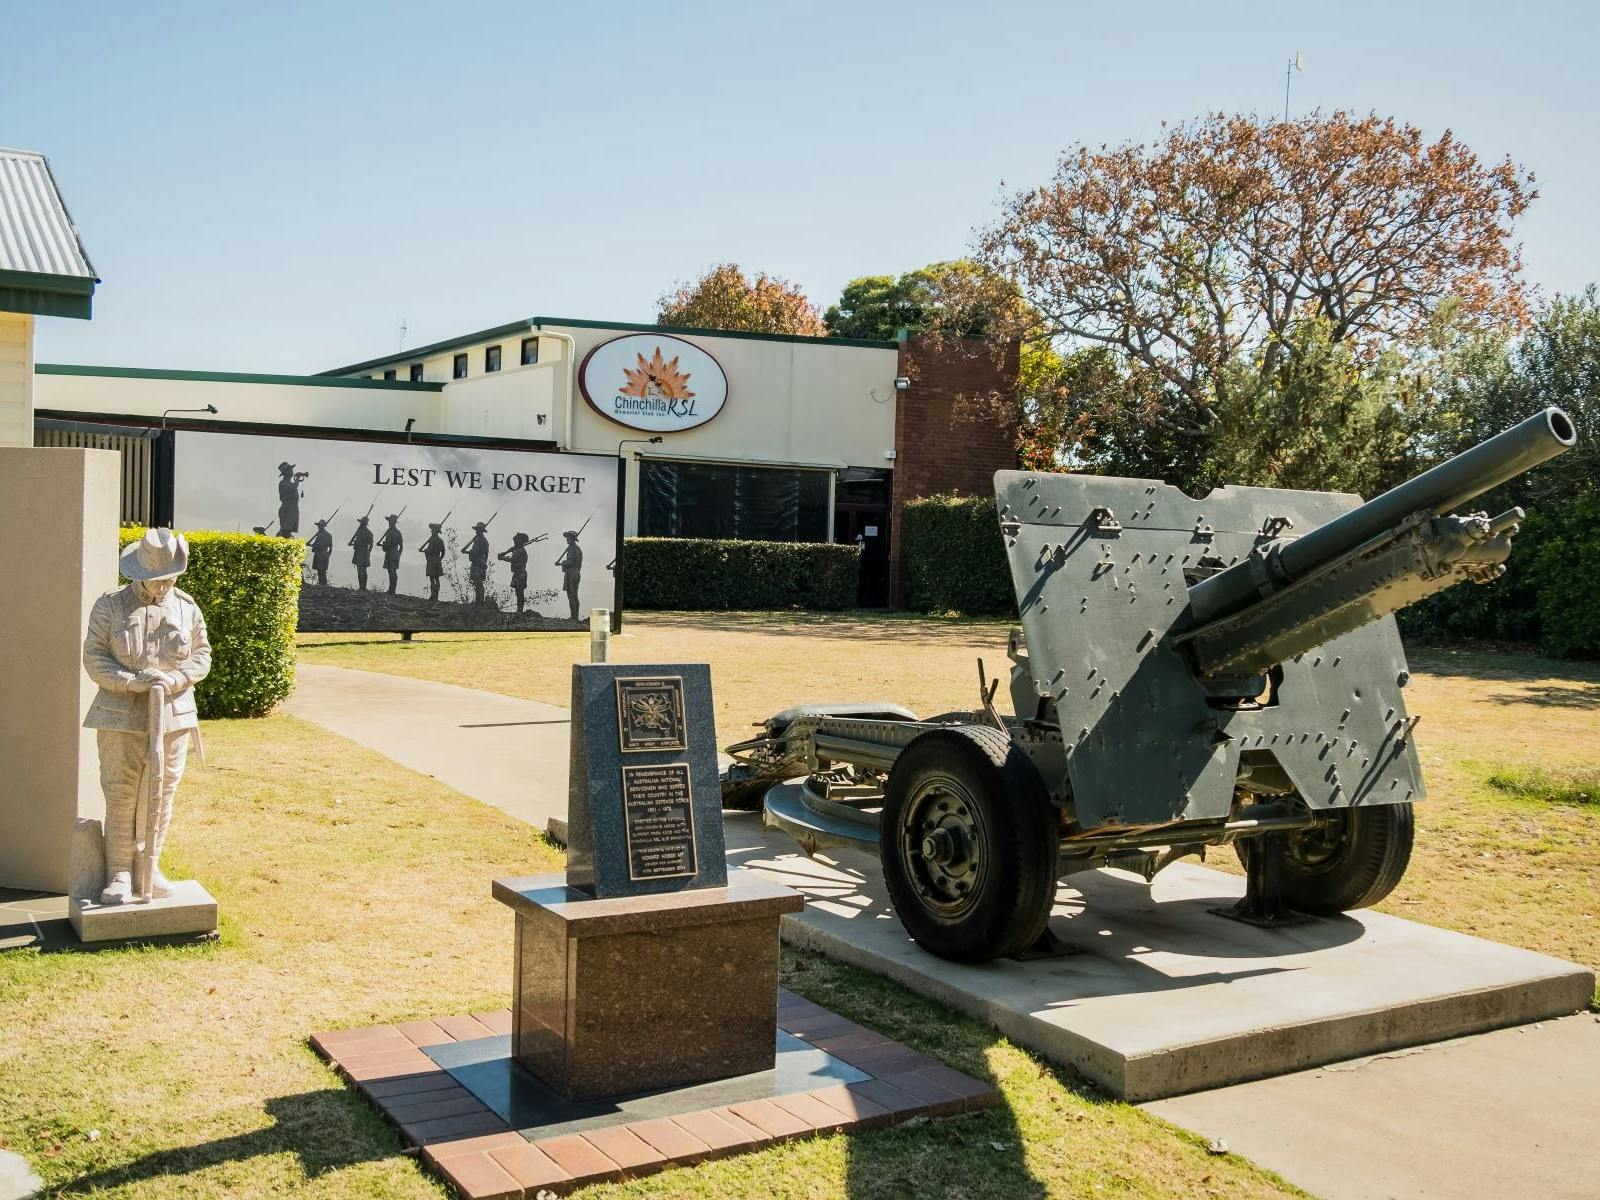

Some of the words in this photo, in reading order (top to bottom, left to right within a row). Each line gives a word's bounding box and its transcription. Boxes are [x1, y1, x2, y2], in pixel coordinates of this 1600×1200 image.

[614, 396, 666, 412] Chinchilla
[668, 398, 699, 418] RSL
[372, 464, 436, 486] LEST
[445, 470, 482, 489] WE
[492, 473, 585, 494] FORGET
